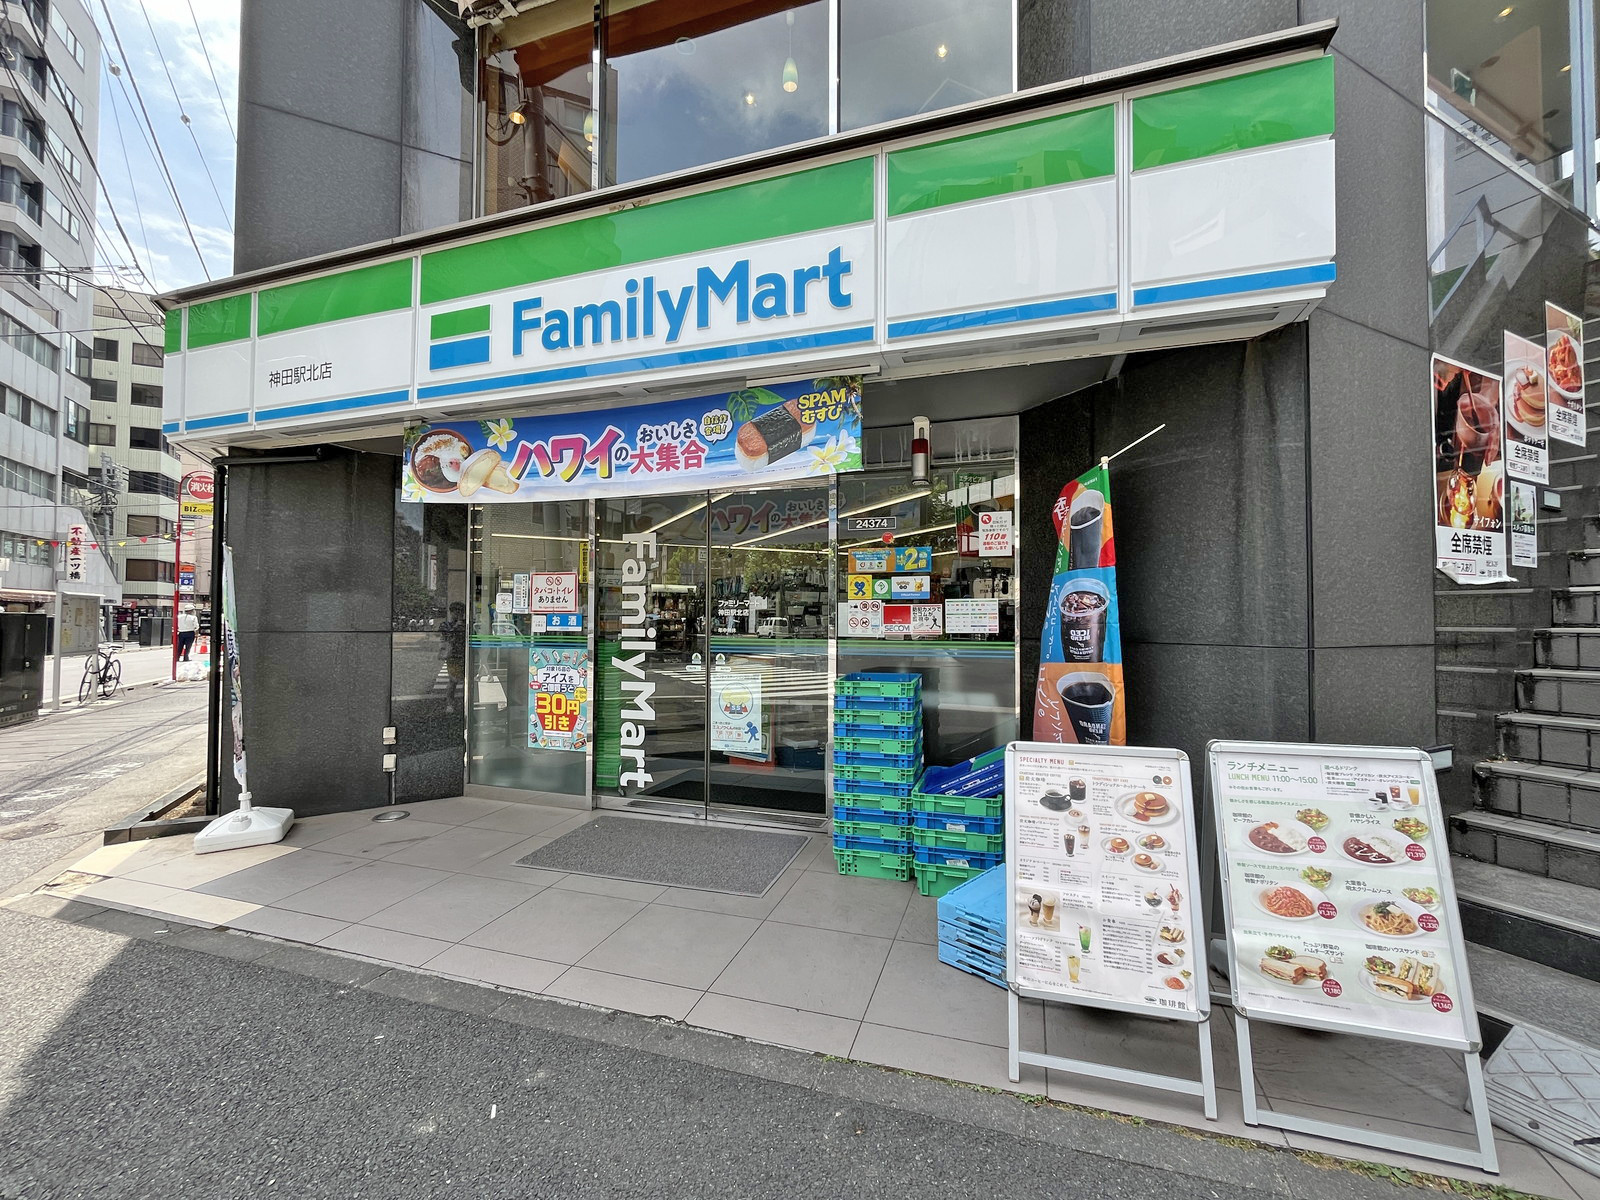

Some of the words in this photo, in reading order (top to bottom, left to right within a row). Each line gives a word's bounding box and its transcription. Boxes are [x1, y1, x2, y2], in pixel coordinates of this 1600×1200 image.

[511, 245, 854, 357] FamilyMart
[268, 361, 334, 389] 神田駅北店
[799, 388, 847, 409] SPAM
[801, 405, 843, 424] むすび
[639, 422, 696, 444] おいしさ
[510, 425, 629, 483] ハワイの
[629, 443, 707, 475] 大集合
[1514, 444, 1540, 463] 全席禁煙
[855, 518, 888, 529] 24374
[1473, 516, 1502, 529] サイフォン
[1450, 532, 1493, 556] 全席禁煙
[69, 526, 83, 580] 不動産一ツ橋
[533, 587, 573, 596] タバコ・トイレ
[538, 595, 569, 604] ありません
[718, 600, 760, 608] ファミリーマート
[718, 609, 750, 617] 神田駅北店
[551, 615, 577, 627] お酒
[884, 624, 910, 632] SECOM
[611, 532, 657, 788] FamilyMart
[542, 672, 574, 683] アイスを
[541, 683, 575, 692] 2個買うと
[536, 692, 580, 716] 30円
[544, 714, 570, 731] 引き
[1019, 756, 1047, 764] SPECIALTY
[1226, 761, 1299, 772] ランチメニュー
[1228, 773, 1250, 781] LUNCH
[1251, 774, 1270, 782] MENU
[1159, 998, 1186, 1009] 珈琲館
